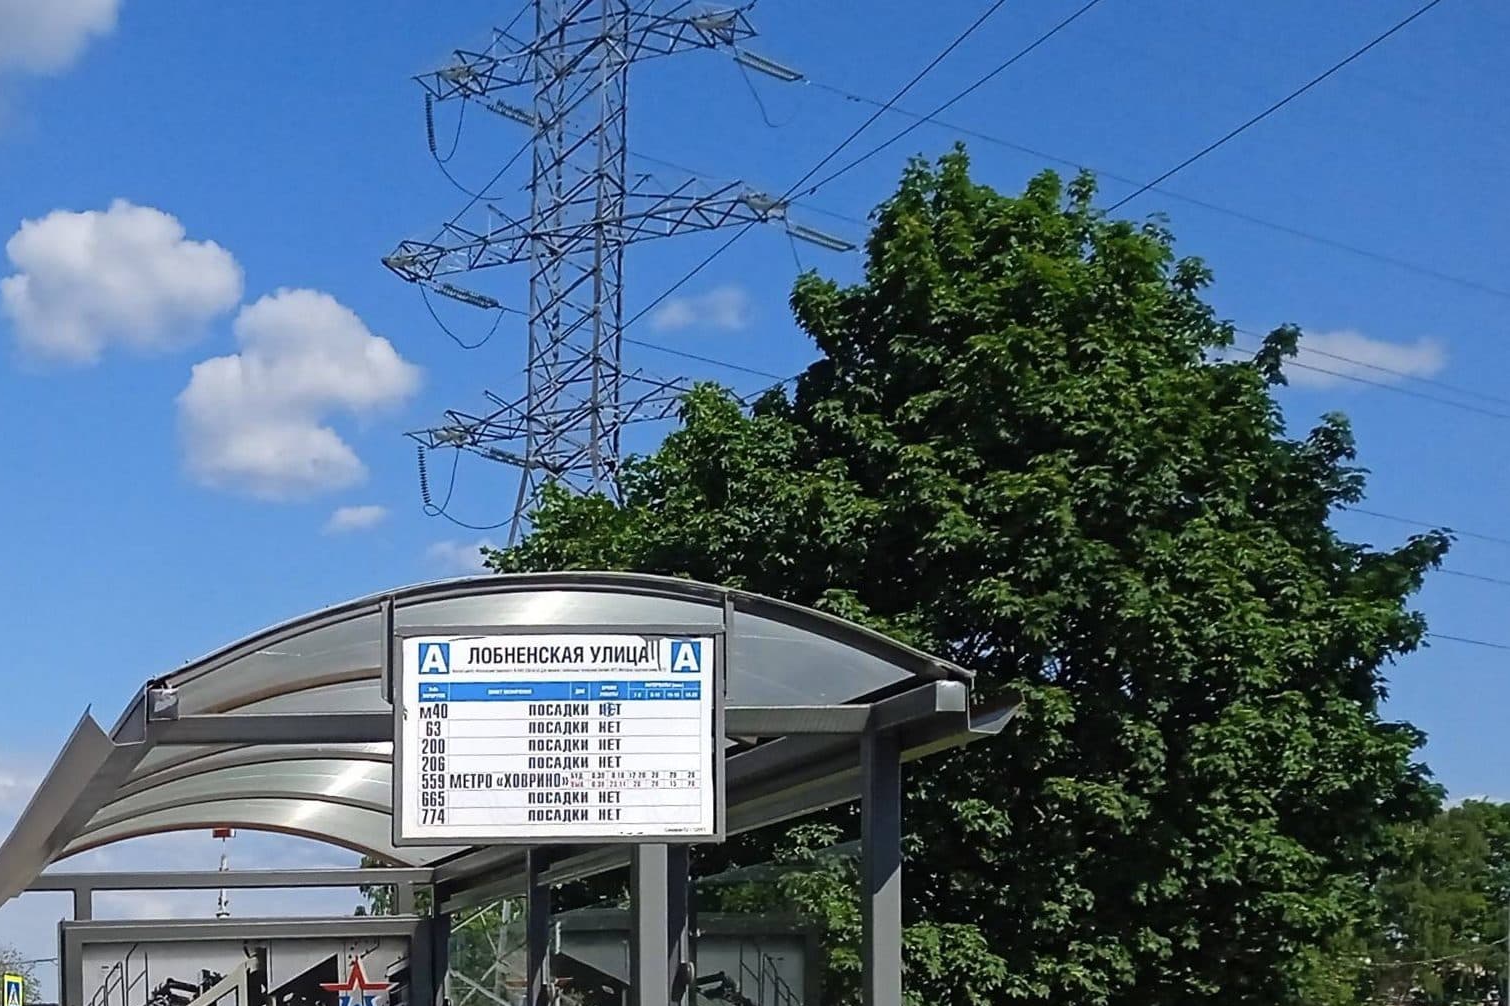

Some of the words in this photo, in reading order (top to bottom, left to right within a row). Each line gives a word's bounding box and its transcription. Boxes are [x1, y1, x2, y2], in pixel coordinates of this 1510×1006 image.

[468, 645, 584, 665] ЛОБНЕНСКАЯ
[590, 645, 649, 666] УЛИЦА
[529, 703, 589, 717] ПОСАДКИ
[426, 721, 441, 737] 63
[529, 721, 589, 735] ПОСАДКИ
[599, 721, 621, 734] НЕТ
[422, 739, 445, 754] 200
[529, 738, 589, 753] ПОСАДКИ
[599, 738, 621, 752] НЕТ
[422, 756, 445, 772] 206
[529, 756, 589, 770] ПОСАДКИ
[599, 756, 621, 769] НЕТ
[422, 774, 445, 789] 559
[450, 774, 492, 788] МЕТРО
[496, 773, 569, 788] «ХОВРИНО»
[422, 791, 445, 807] 665
[529, 791, 589, 805] ПОСАДКИ
[599, 791, 621, 804] НЕТ
[422, 809, 445, 824] 774
[529, 809, 589, 822] ПОСАДКИ
[599, 809, 621, 821] НЕТ
